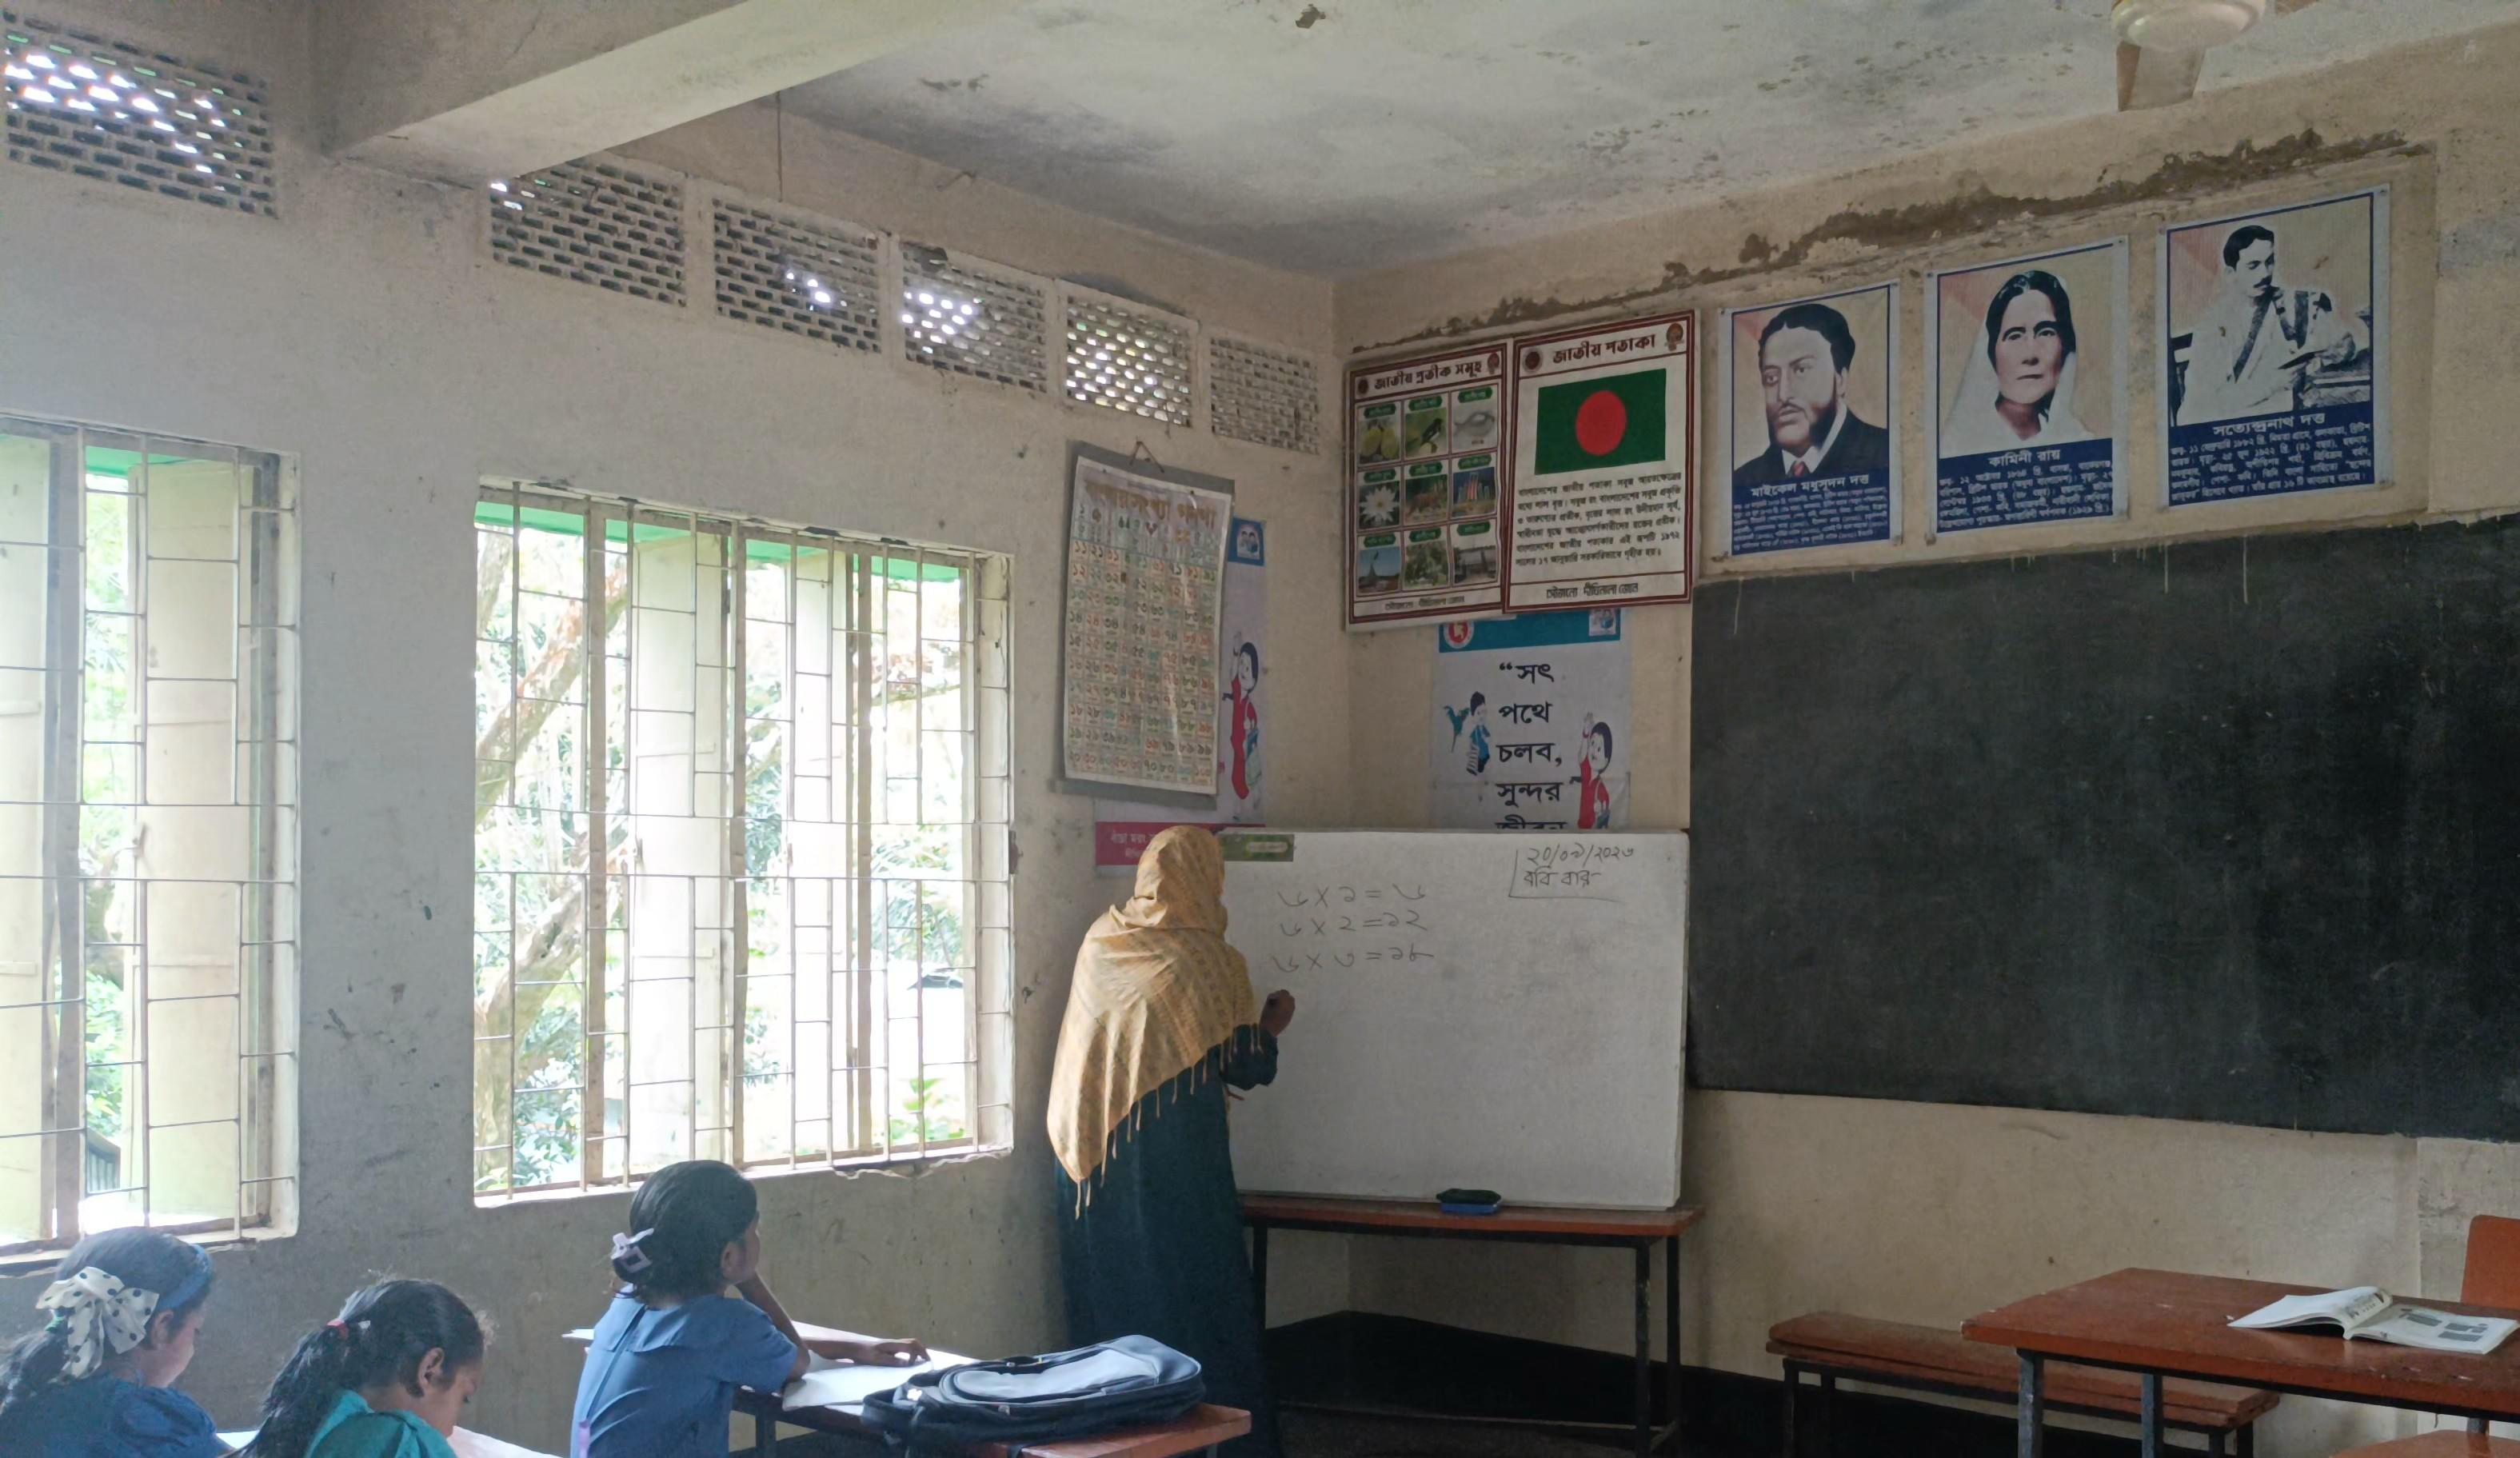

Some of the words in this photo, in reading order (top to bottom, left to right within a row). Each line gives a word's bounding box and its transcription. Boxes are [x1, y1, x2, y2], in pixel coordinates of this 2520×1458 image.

[1553, 341, 1601, 363] জাতীয়
[1605, 334, 1655, 354] পতাকা
[1374, 371, 1412, 389] জাতীয়
[1416, 365, 1452, 384] প্রতীক
[1455, 362, 1482, 378] সমূহ
[2213, 415, 2294, 437] সত্যেন্দ্রনাথ
[2299, 413, 2325, 425] দত্ত
[1987, 449, 2032, 467] কামিনী
[2036, 449, 2061, 461] রায়
[1751, 482, 1797, 497] মাইকেল
[1801, 477, 1846, 493] মধুসূদন
[1849, 473, 1870, 485] দত্ত
[1499, 662, 1554, 684] “সৎ
[1498, 701, 1553, 724] পথে
[1496, 743, 1562, 766] চলব,
[1495, 781, 1564, 807] সুন্দর
